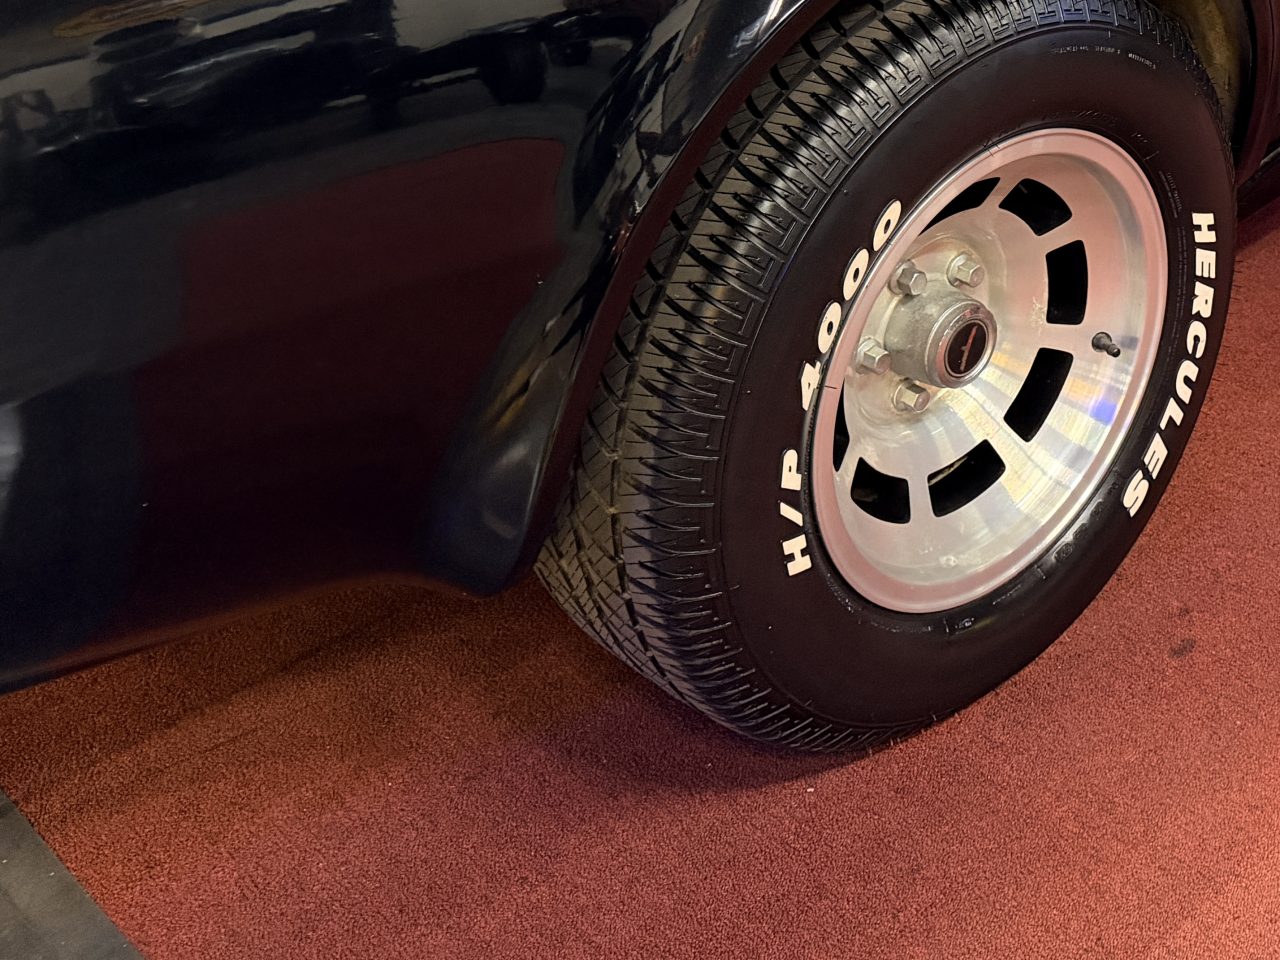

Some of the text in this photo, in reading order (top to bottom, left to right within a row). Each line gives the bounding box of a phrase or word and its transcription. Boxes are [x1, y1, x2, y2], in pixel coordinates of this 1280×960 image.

[780, 199, 902, 576] H/P 4000
[1122, 212, 1217, 517] HERCULES
